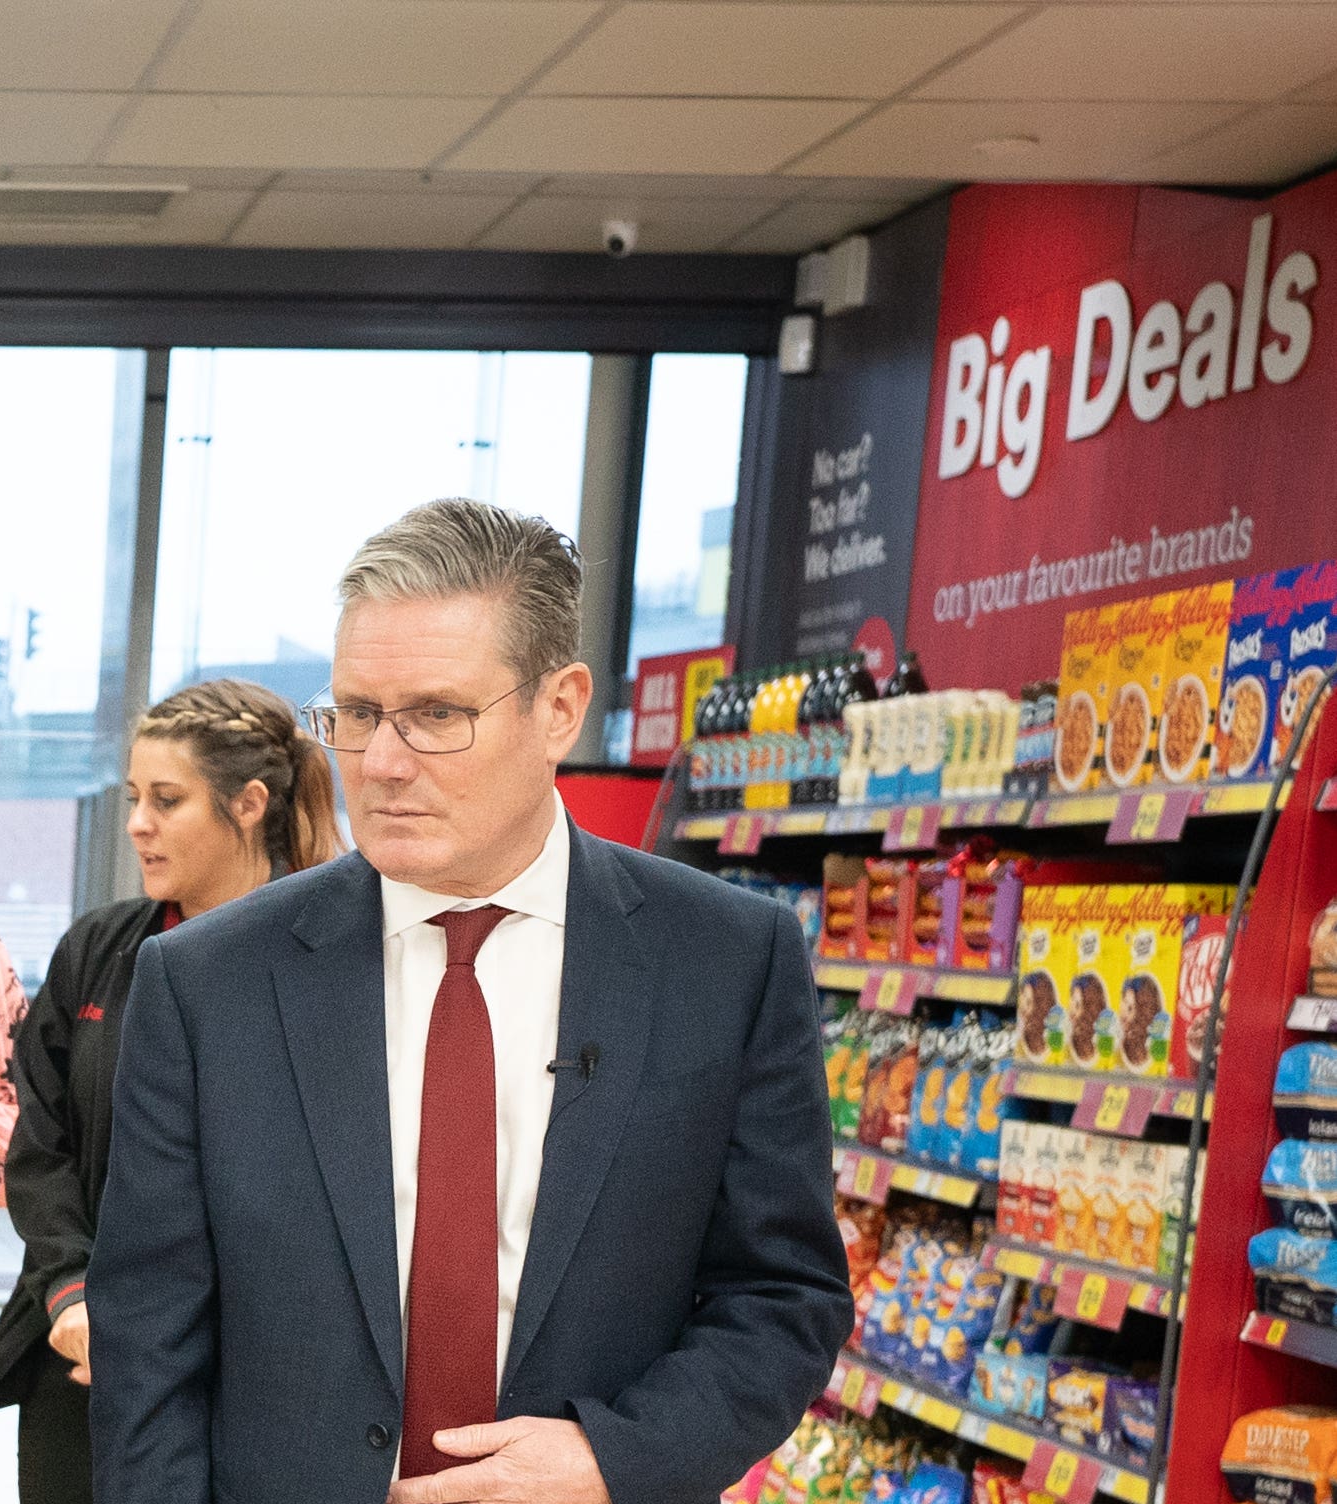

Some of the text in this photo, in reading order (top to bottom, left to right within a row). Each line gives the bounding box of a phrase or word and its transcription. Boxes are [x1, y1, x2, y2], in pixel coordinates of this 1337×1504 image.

[938, 212, 1320, 499] Big Deals
[933, 505, 1254, 628] on your favourite brands
